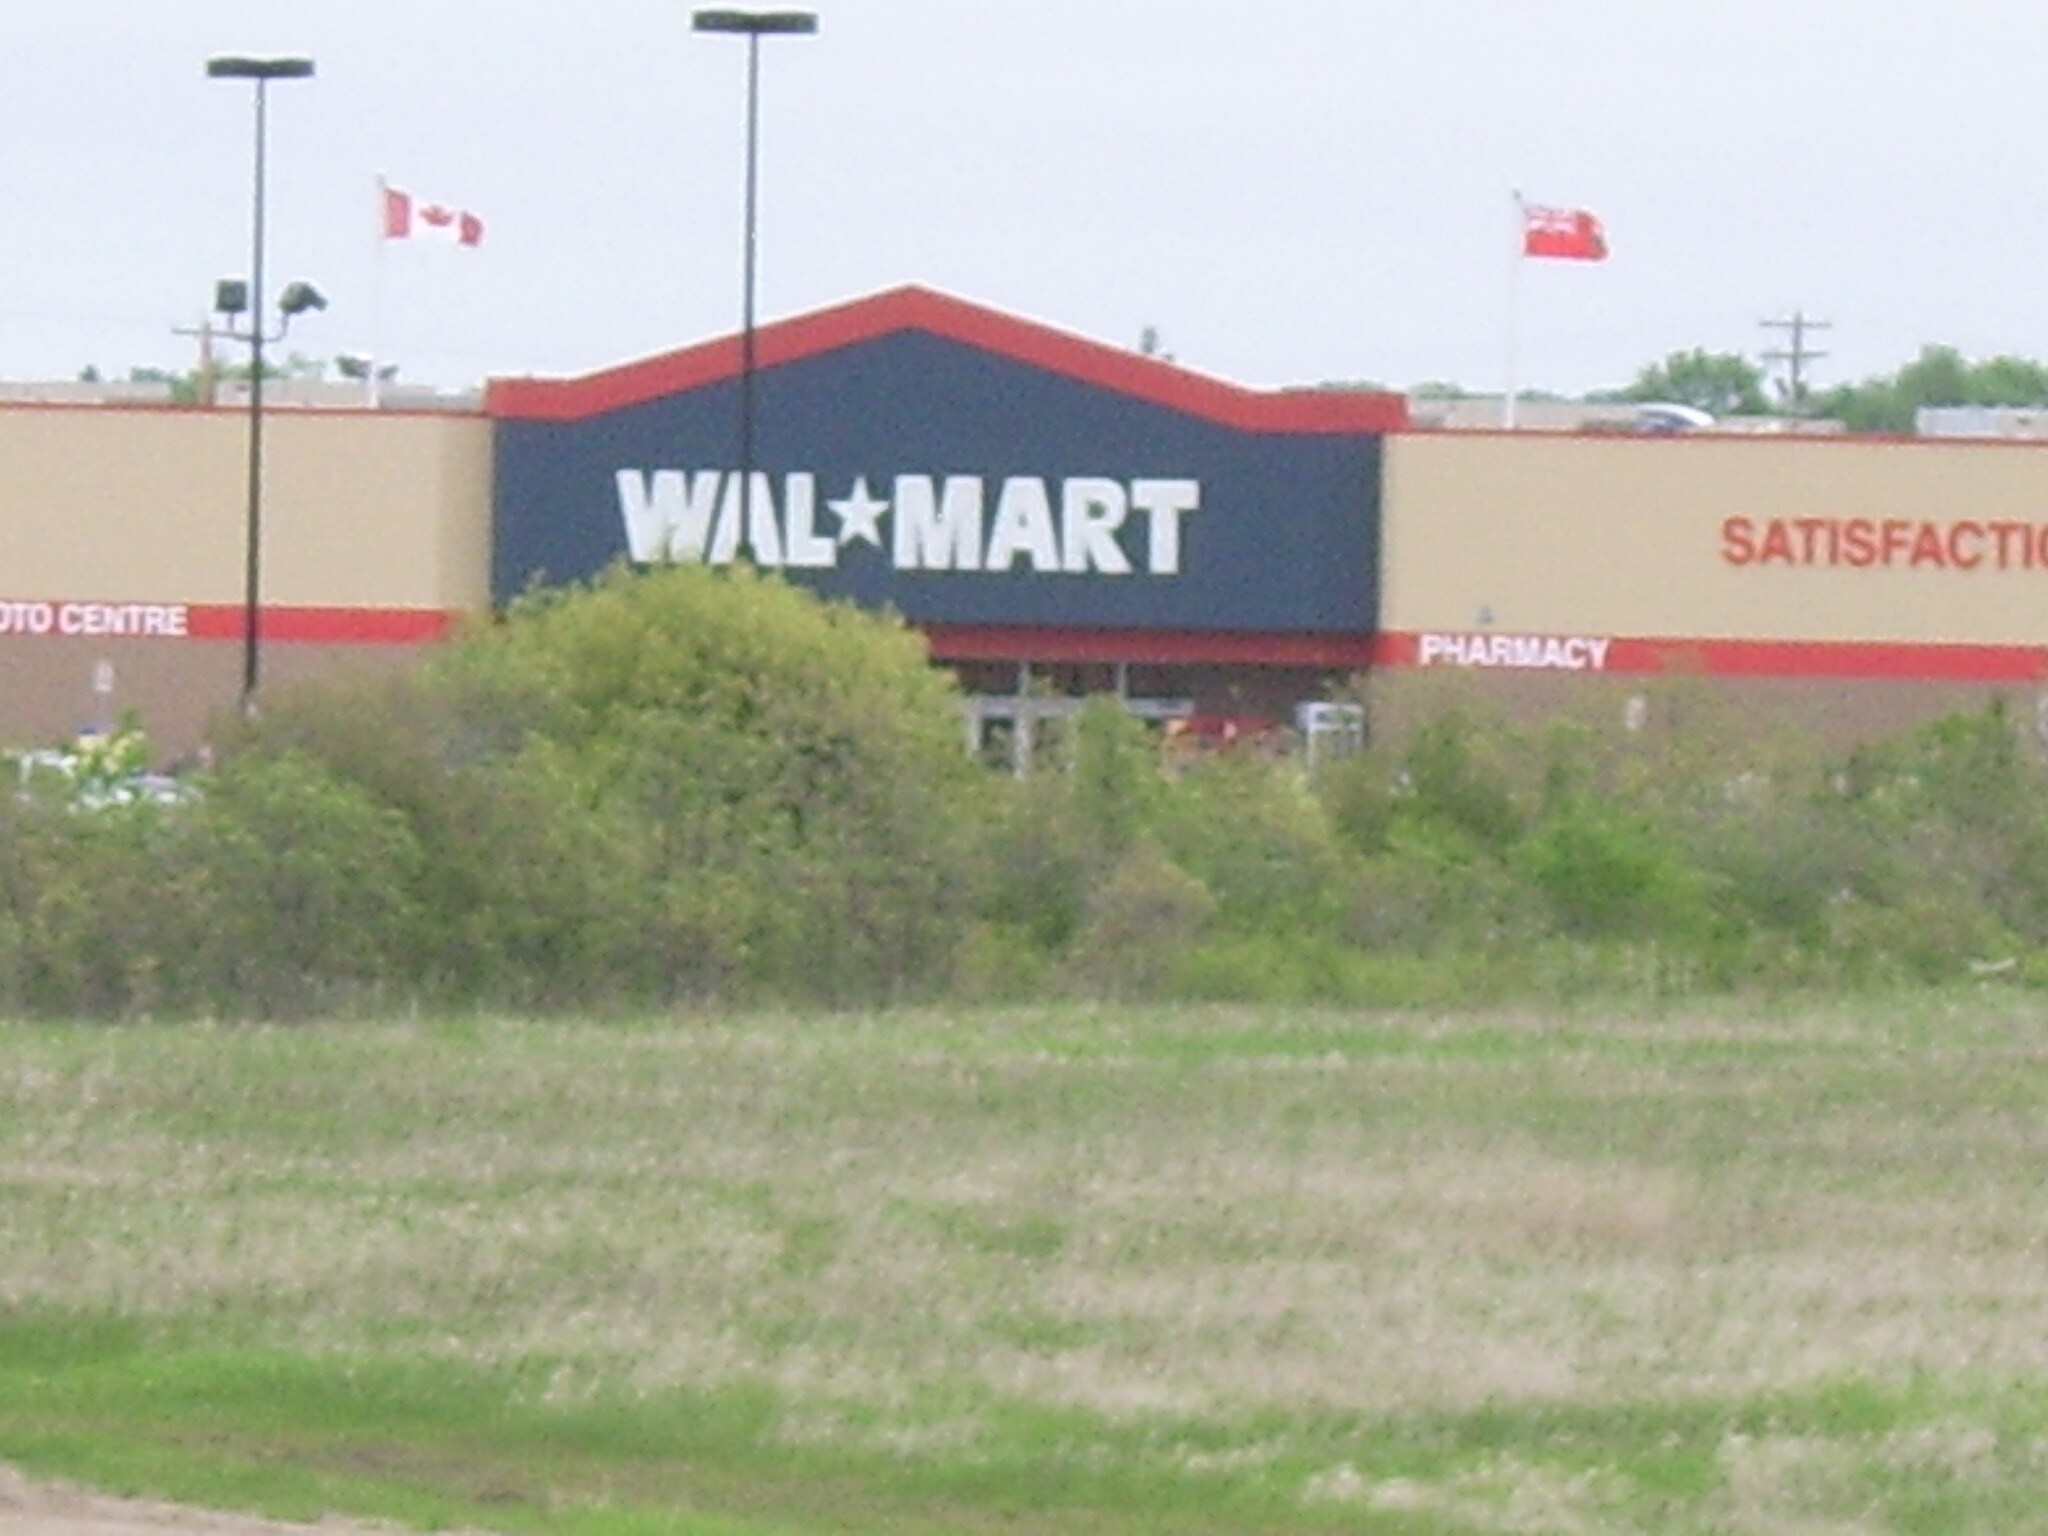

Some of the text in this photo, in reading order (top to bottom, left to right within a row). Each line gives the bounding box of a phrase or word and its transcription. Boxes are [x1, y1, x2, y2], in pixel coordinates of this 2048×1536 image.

[1721, 516, 2048, 570] SATISFACTI
[59, 603, 188, 635] CENTRE
[1419, 634, 1609, 669] PHARMACY
